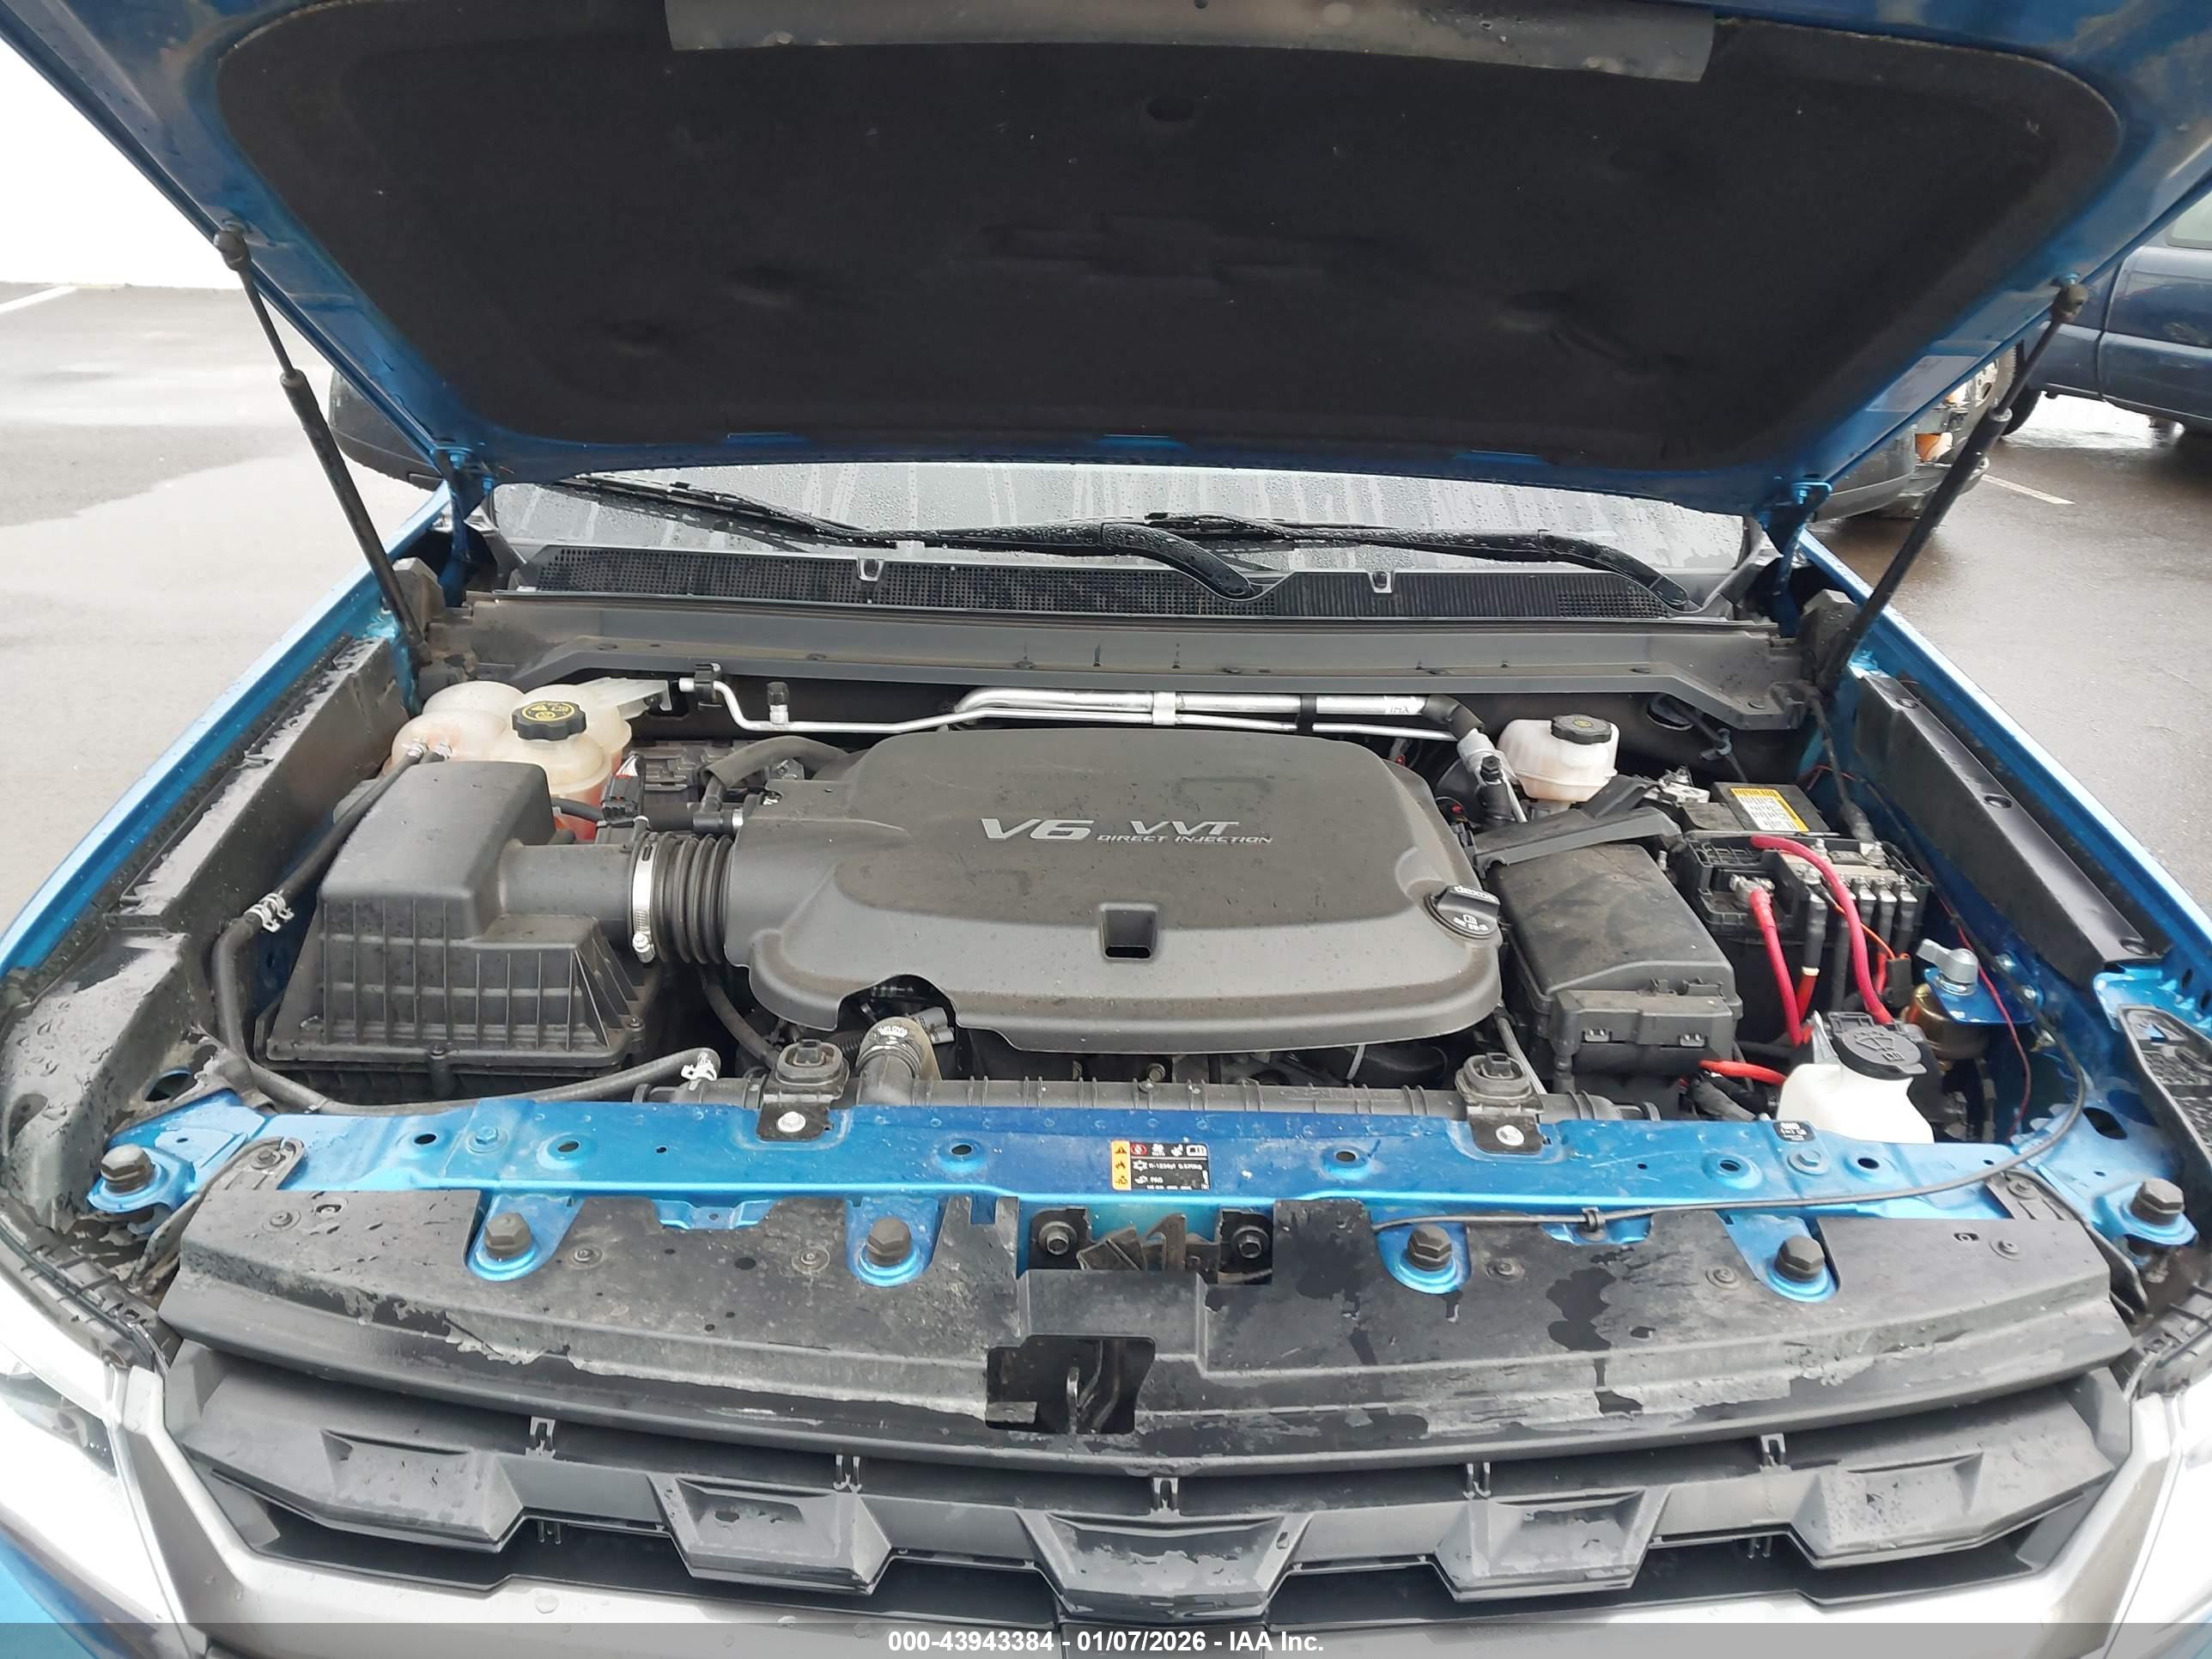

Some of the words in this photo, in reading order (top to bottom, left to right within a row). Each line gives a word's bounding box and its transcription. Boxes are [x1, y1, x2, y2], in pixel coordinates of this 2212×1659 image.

[981, 818, 1094, 841] V6
[1130, 820, 1240, 836] VVT
[1174, 836, 1273, 844] INJECTION
